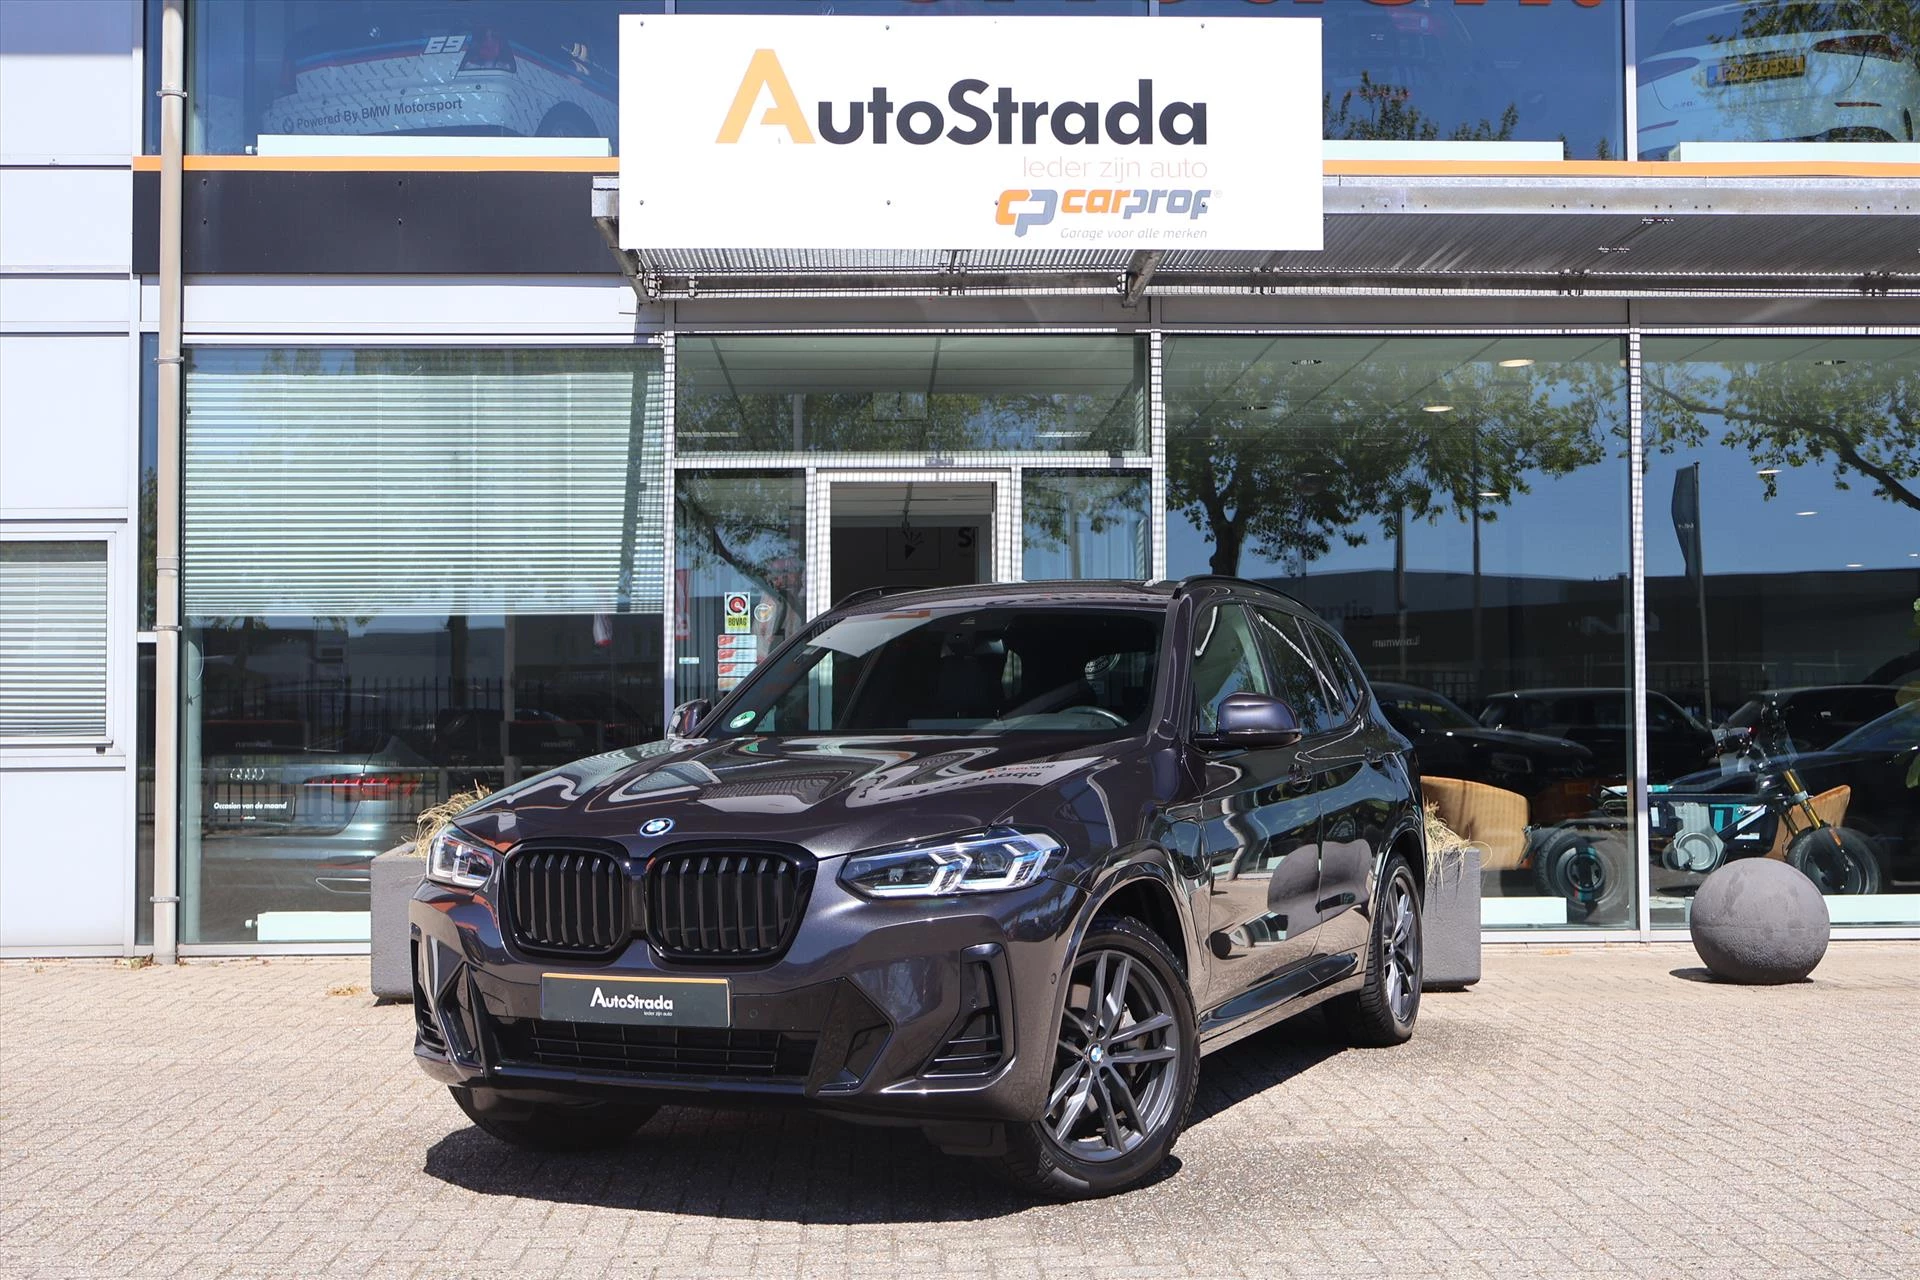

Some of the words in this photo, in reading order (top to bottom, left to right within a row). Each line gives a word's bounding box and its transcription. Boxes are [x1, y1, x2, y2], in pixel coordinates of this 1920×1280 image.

[424, 35, 467, 54] 69
[715, 48, 1207, 145] AutoStrada
[297, 111, 341, 128] Powered
[343, 110, 357, 123] By
[362, 105, 390, 119] BMW
[394, 98, 463, 115] Motorsport
[1023, 156, 1091, 178] Ieder
[1100, 157, 1141, 183] zijn
[1150, 158, 1208, 178] auto
[1061, 189, 1212, 220] carprof
[1060, 228, 1103, 242] Garage
[1109, 230, 1135, 239] voor
[1138, 228, 1161, 239] alle
[1164, 228, 1208, 239] merken
[213, 801, 241, 810] Occasion
[255, 801, 264, 810] de
[264, 801, 288, 810] maand
[590, 987, 674, 1011] AutoStrada
